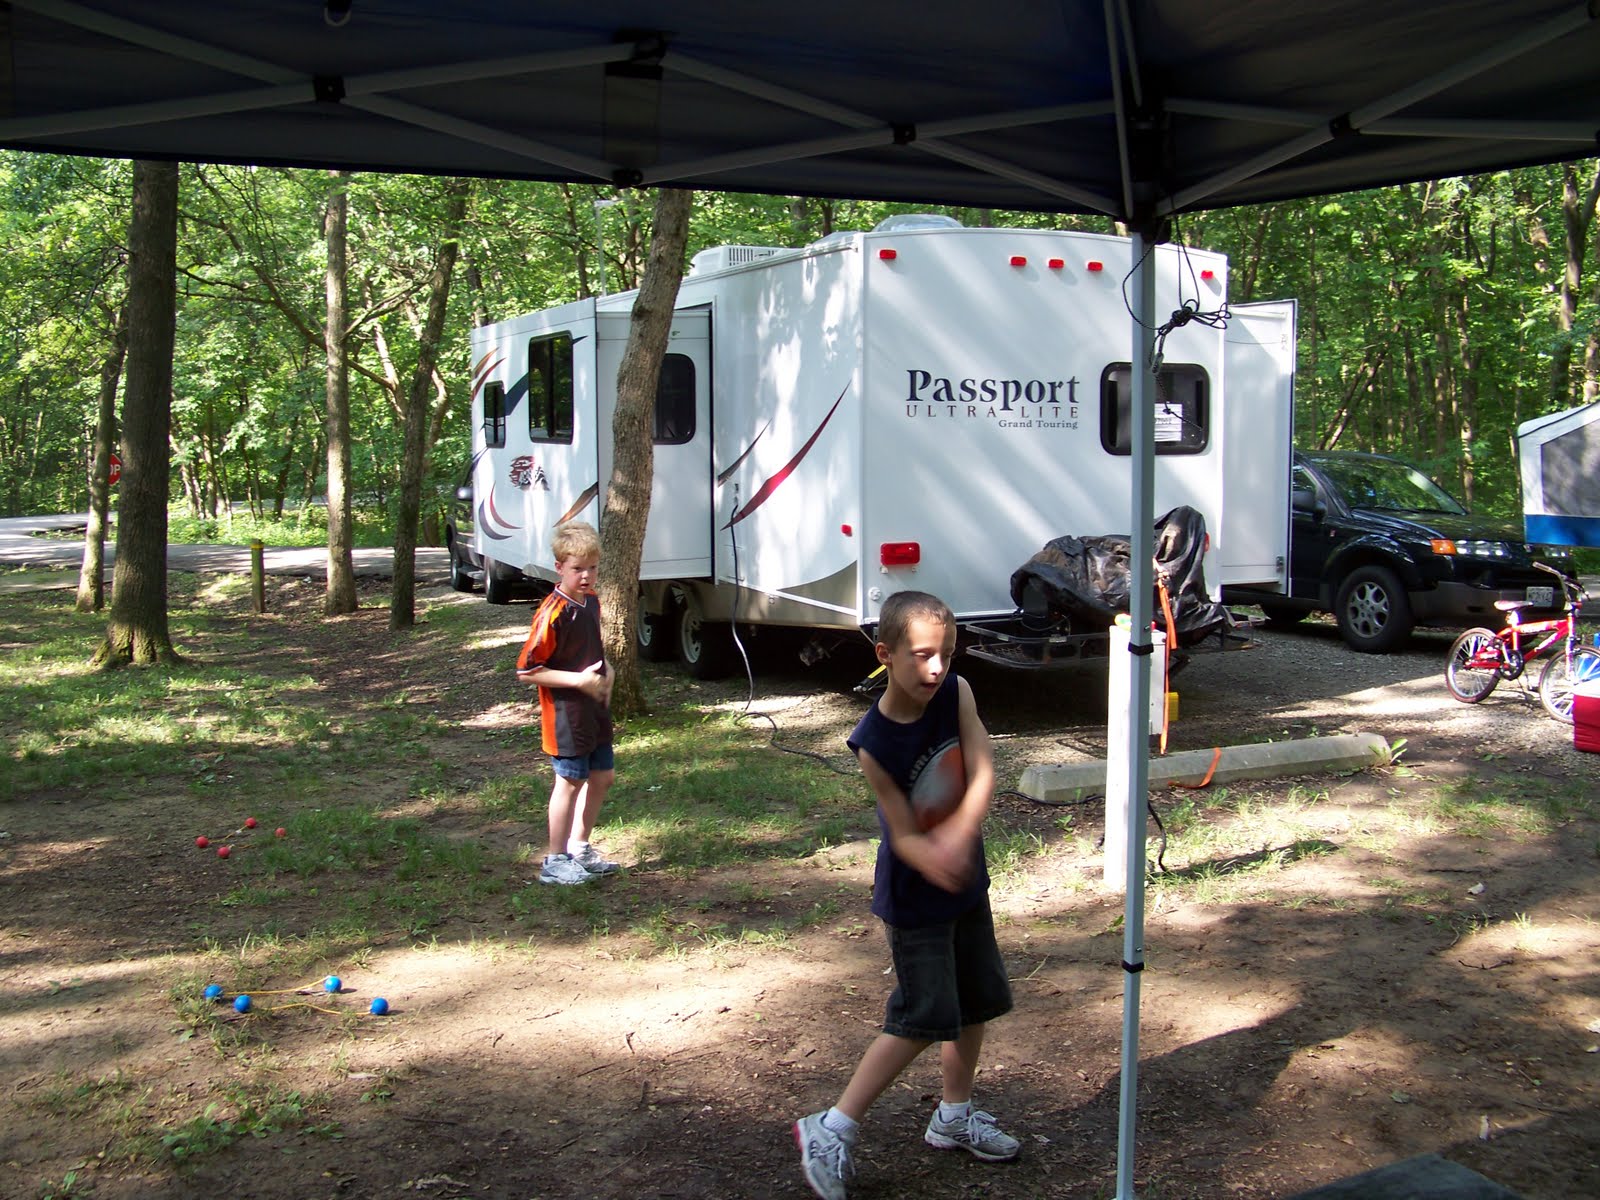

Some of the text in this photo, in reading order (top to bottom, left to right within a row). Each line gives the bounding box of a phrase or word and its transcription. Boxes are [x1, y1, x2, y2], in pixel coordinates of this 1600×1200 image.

[906, 369, 1080, 411] Passport
[906, 405, 1079, 419] ULTRA LITE
[998, 419, 1079, 430] Grand Touring
